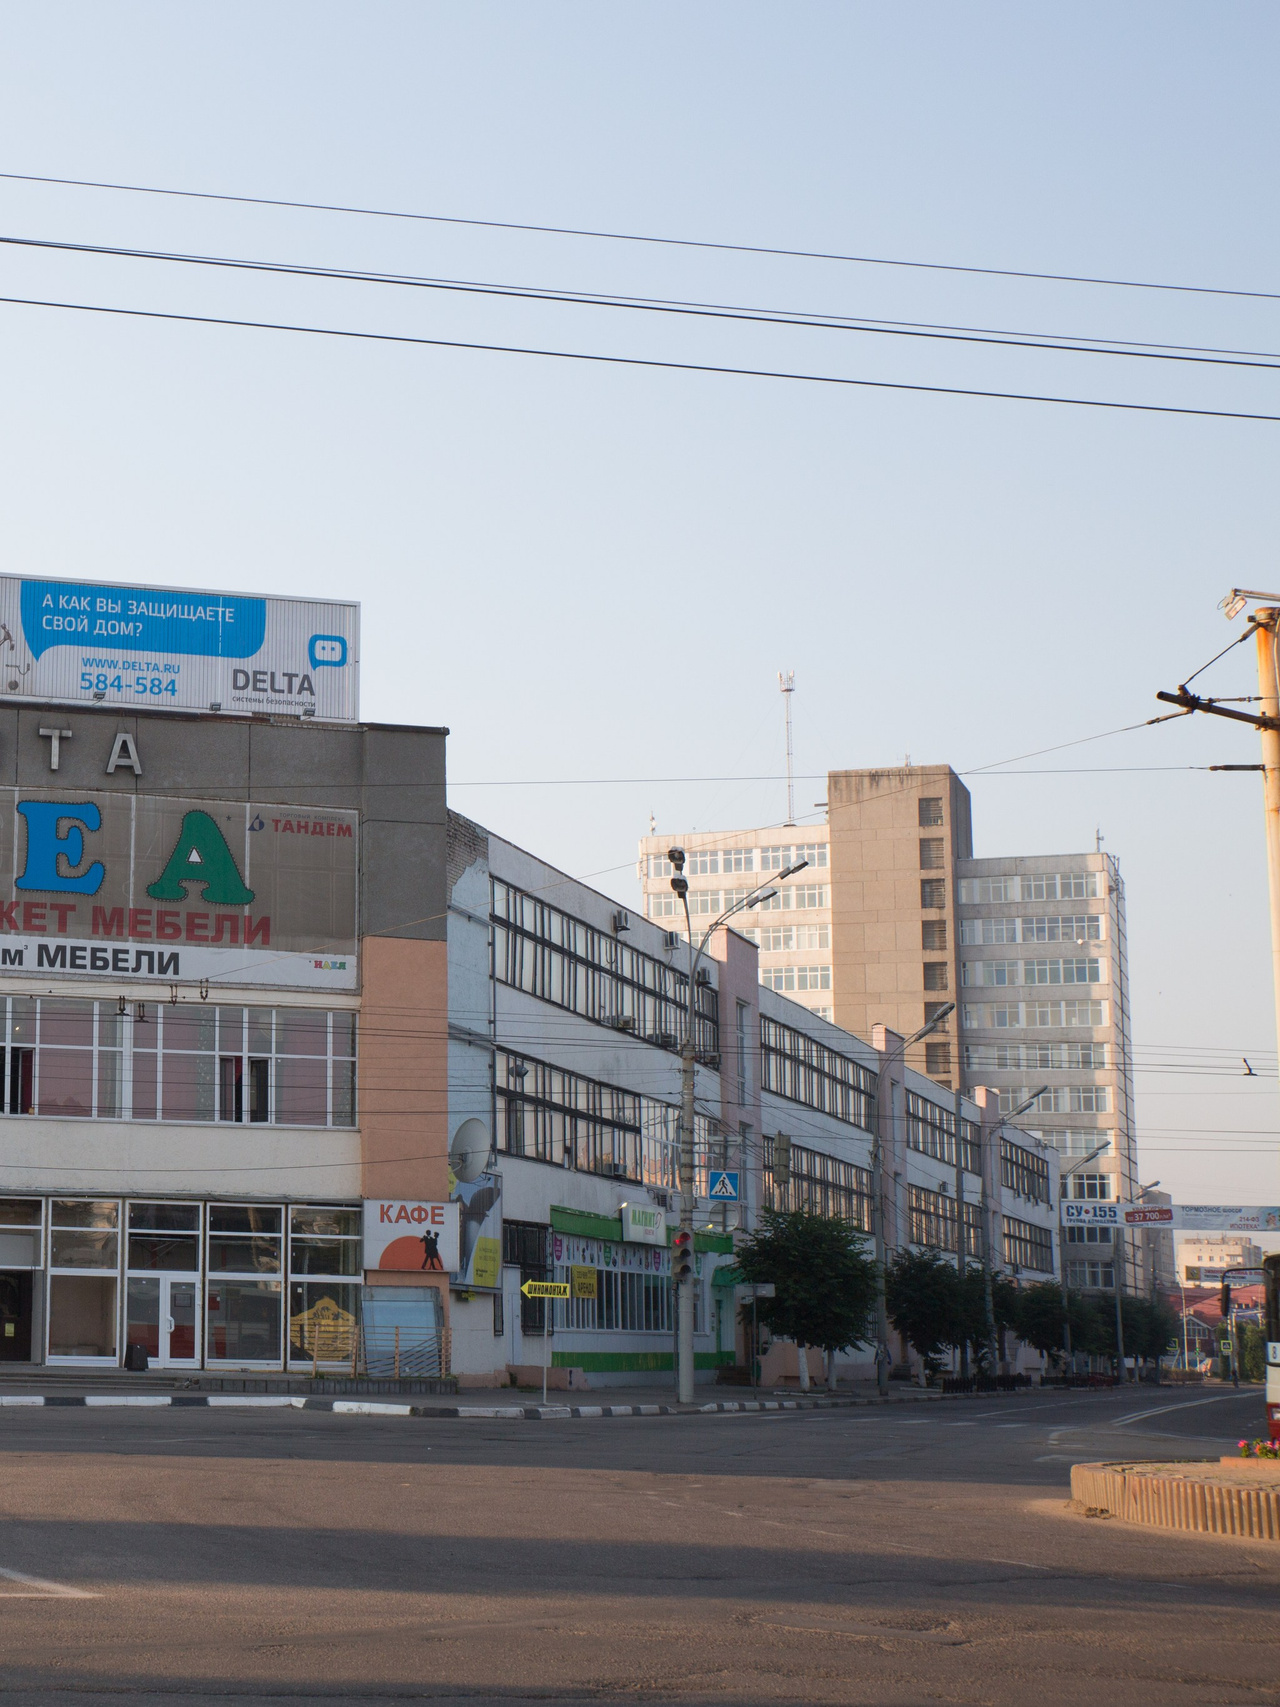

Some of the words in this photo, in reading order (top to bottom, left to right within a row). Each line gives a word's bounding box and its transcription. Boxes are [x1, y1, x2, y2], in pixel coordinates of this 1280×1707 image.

[42, 594, 54, 608] А
[59, 595, 91, 612] КАК
[96, 598, 121, 613] ВЫ
[127, 600, 235, 622] ЗАЩИЩАЕТЕ
[42, 615, 88, 632] СВОЙ
[93, 620, 143, 637] ДОМ?
[82, 657, 181, 674] WWW.DELTA.RU
[80, 672, 178, 697] 584-584
[232, 668, 316, 697] DELTA
[232, 696, 264, 704] системы
[266, 696, 316, 708] безопасности
[272, 818, 353, 838] ТАНДЕМ
[91, 905, 271, 946] МЕБЕЛИ
[37, 943, 180, 976] МЕБЕЛИ
[380, 1203, 445, 1226] КАФЕ
[1134, 1213, 1144, 1221] 37
[1145, 1212, 1160, 1220] 700
[1181, 1206, 1221, 1214] ТОРМОЗНОЕ
[527, 1283, 568, 1297] ШИНОМОНТАЖ
